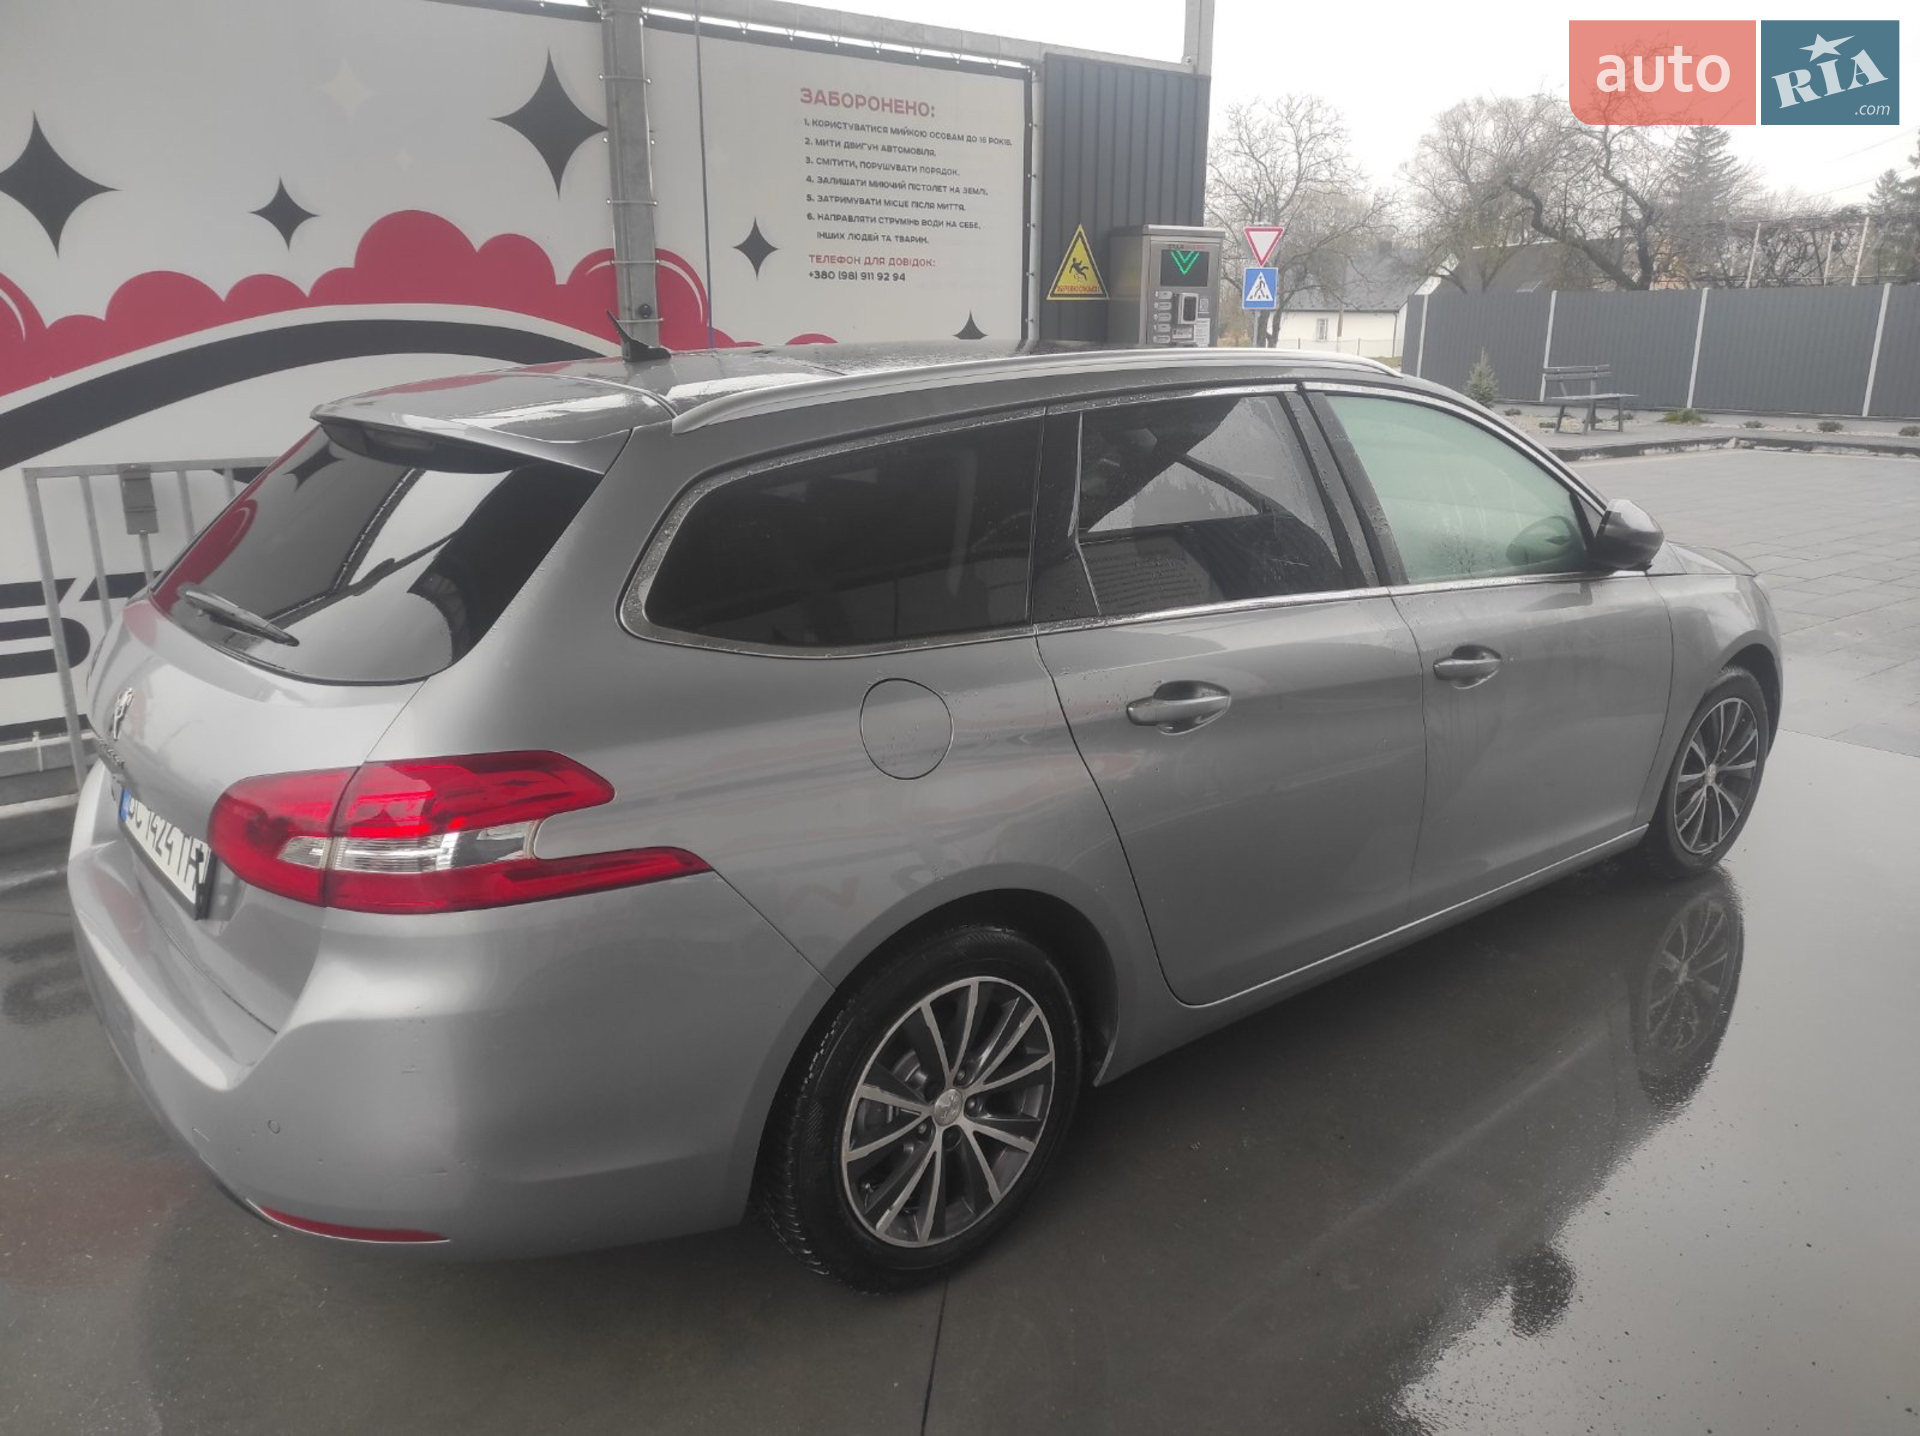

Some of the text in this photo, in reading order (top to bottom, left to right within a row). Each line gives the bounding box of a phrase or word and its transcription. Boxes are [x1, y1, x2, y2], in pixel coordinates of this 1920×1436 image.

[800, 87, 935, 118] ЗАБОРОНЕНО:
[811, 119, 889, 134] КОРИСТУВАТИСЯ
[890, 126, 928, 138] МИЙКОЮ
[929, 131, 964, 142] ОСОБАМ
[966, 135, 978, 143] ДО
[804, 137, 937, 157] 2. МИТИ ДВИГУН АВТОМОВІЛЯ.
[805, 156, 960, 176] 3. СМІТИТИ, ПОРУШУВАТИ ПОРЯДОК.
[805, 175, 814, 183] 4.
[816, 176, 867, 187] ЗАЛИШАТИ
[868, 180, 907, 190] МИЮЧИЙ
[908, 183, 948, 193] ПІСТОЛЕТ
[806, 194, 815, 202] 5.
[816, 195, 882, 206] ЗАТРИМУВАТИ
[883, 199, 909, 208] МІСЦЕ
[911, 201, 936, 210] ПІСЛЯ
[806, 212, 816, 220] 6.
[817, 213, 877, 224] НАПРАВЛЯТИ
[878, 216, 920, 227] СТРУМІНЬ
[921, 218, 944, 228] ВОДИ
[946, 221, 957, 229] НА
[816, 231, 930, 244] ІНШИХ ЛЮДЕЙ ТА ТВАРИН.
[808, 254, 937, 268] ТЕЛЕФОН ДЛЯ ДОВІДОК:
[808, 270, 906, 282] +380 (98) 911 92 94
